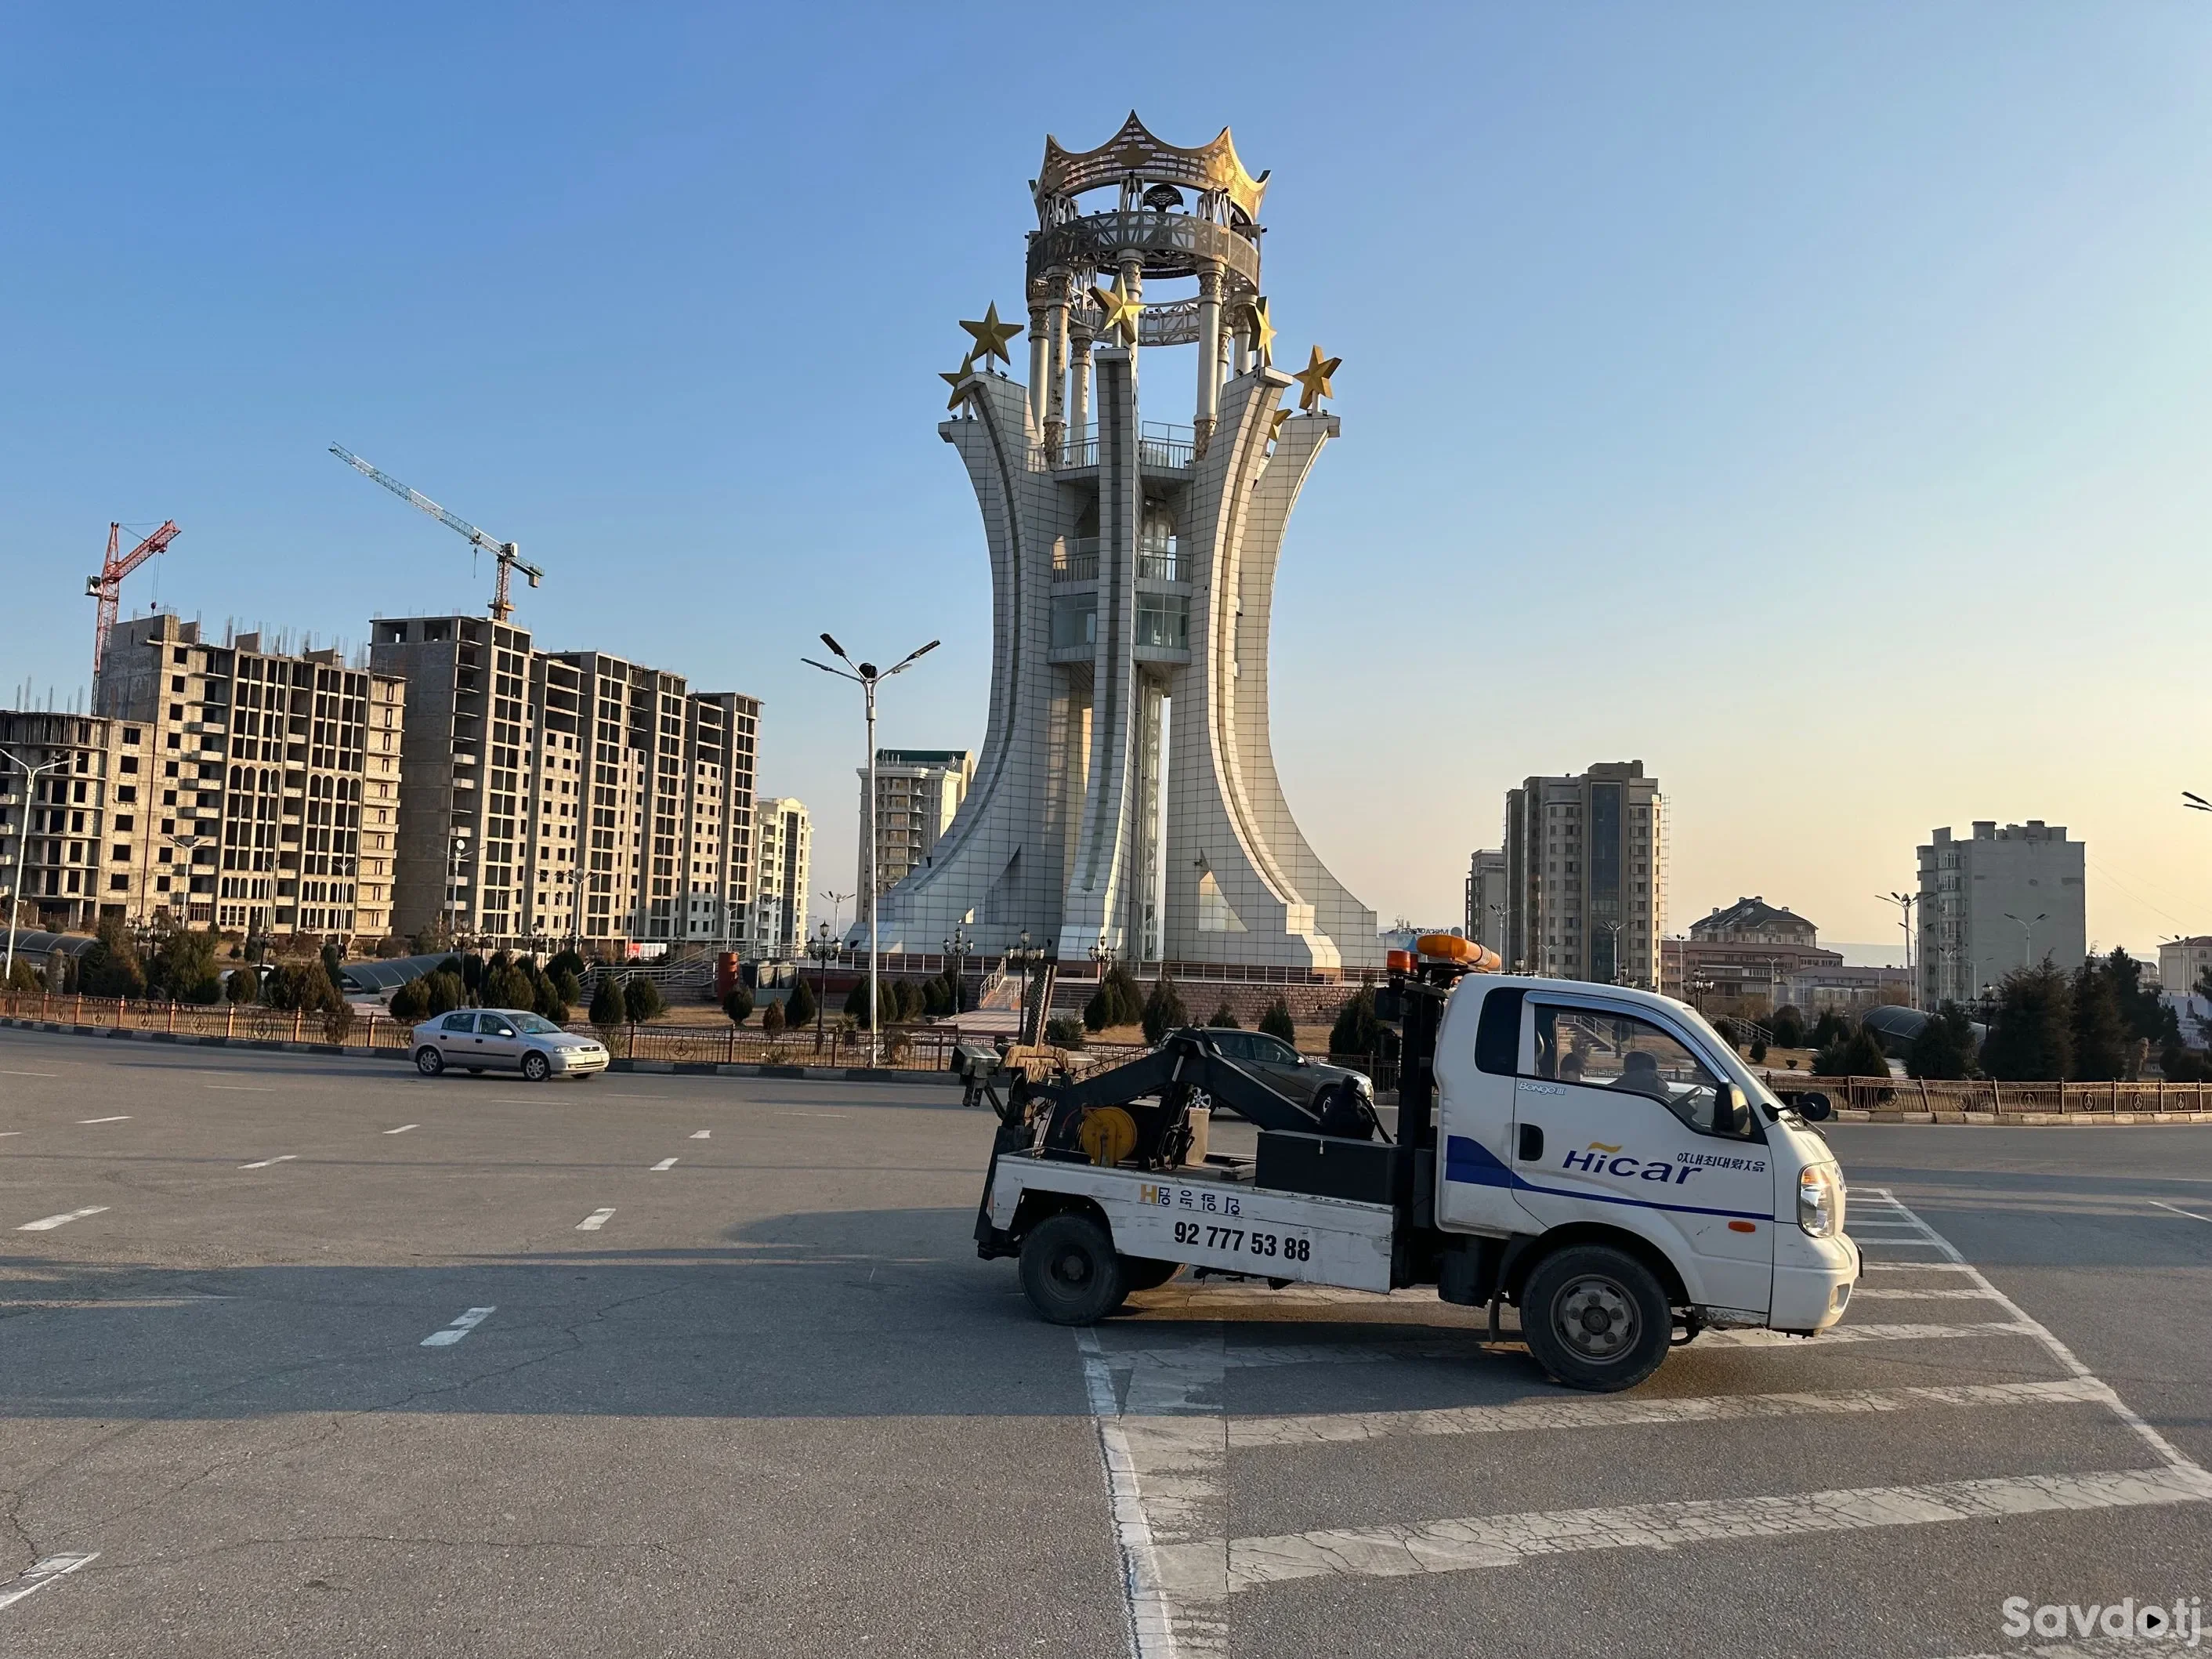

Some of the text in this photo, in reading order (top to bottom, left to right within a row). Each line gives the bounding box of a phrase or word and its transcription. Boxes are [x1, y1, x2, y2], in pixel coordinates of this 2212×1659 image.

[1562, 1150, 1703, 1184] Hicar
[1175, 1222, 1310, 1262] 92 777 53 88
